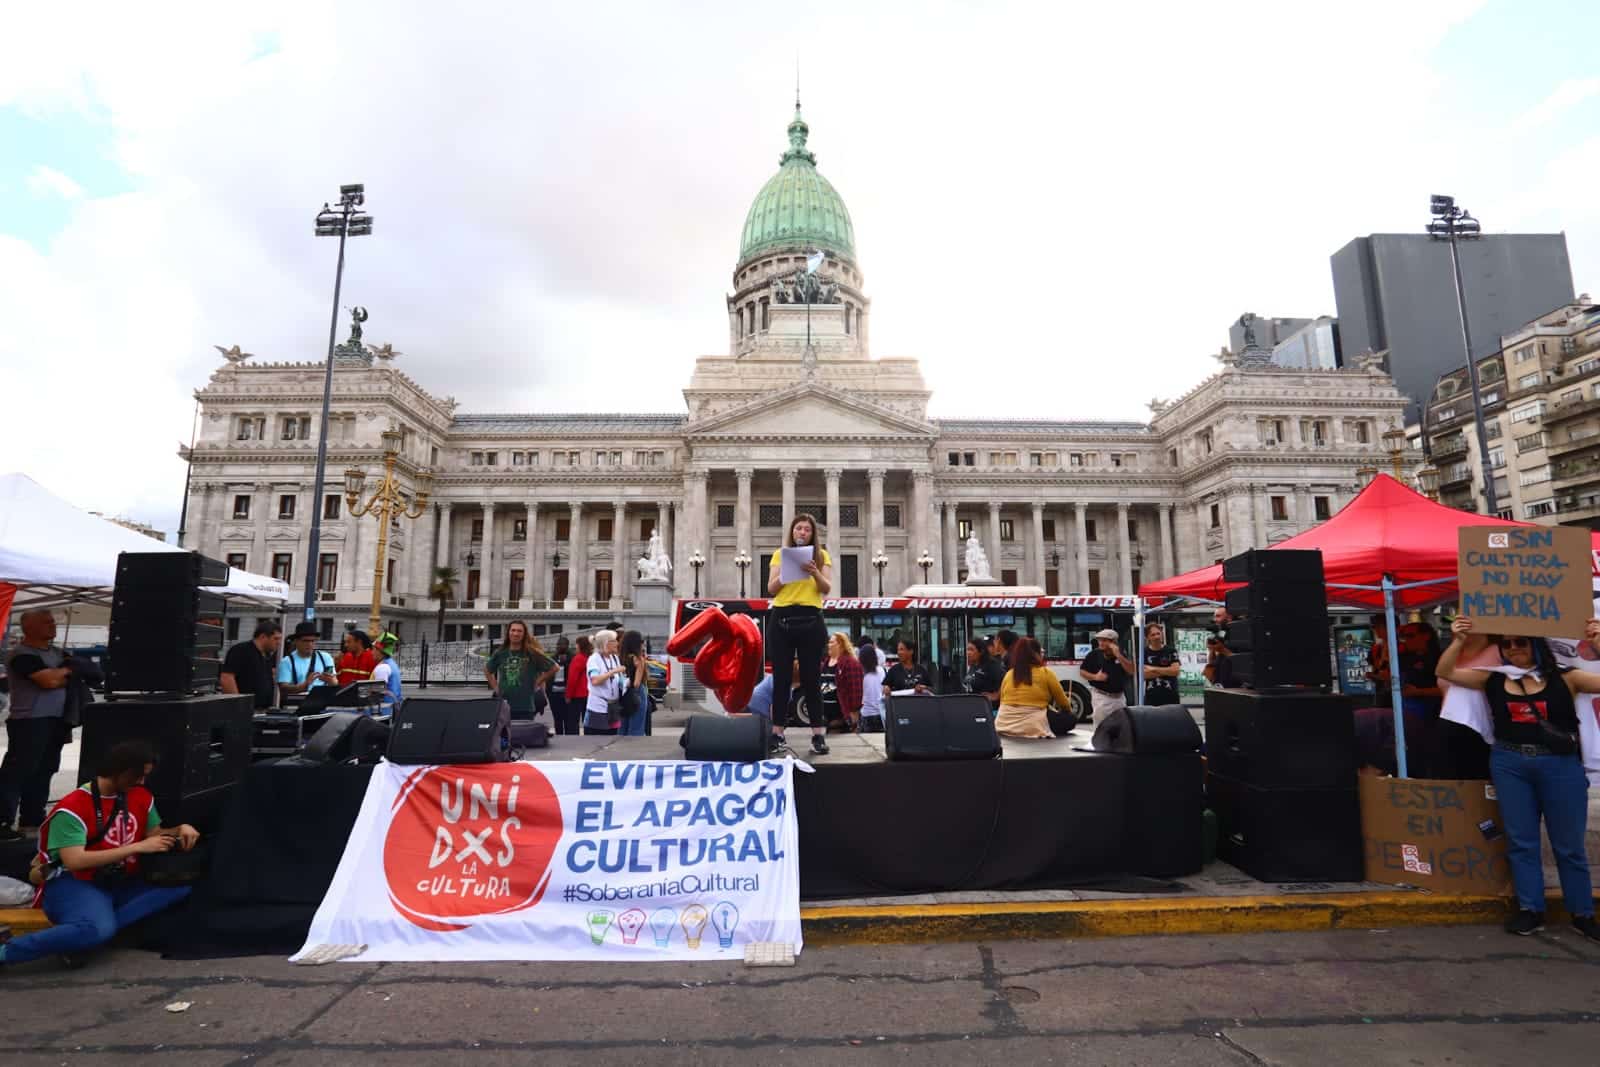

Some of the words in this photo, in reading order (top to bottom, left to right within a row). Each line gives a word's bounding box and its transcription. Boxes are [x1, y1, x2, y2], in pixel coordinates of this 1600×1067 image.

[1509, 528, 1553, 549] SIN
[1466, 551, 1569, 569] CULTURA
[1482, 570, 1509, 586] NO
[1519, 570, 1564, 588] HAY
[905, 598, 1038, 609] AUTOMOTORES
[1051, 597, 1118, 608] CALLAO
[1463, 591, 1562, 621] MEMORIA
[580, 761, 784, 790] EVITEMOS
[575, 800, 624, 834] EL
[1407, 814, 1445, 837] EN
[428, 816, 522, 869] DXS
[566, 829, 785, 873] CULTURAL
[462, 861, 478, 875] LA
[563, 873, 760, 902] #SoberaníaCultural
